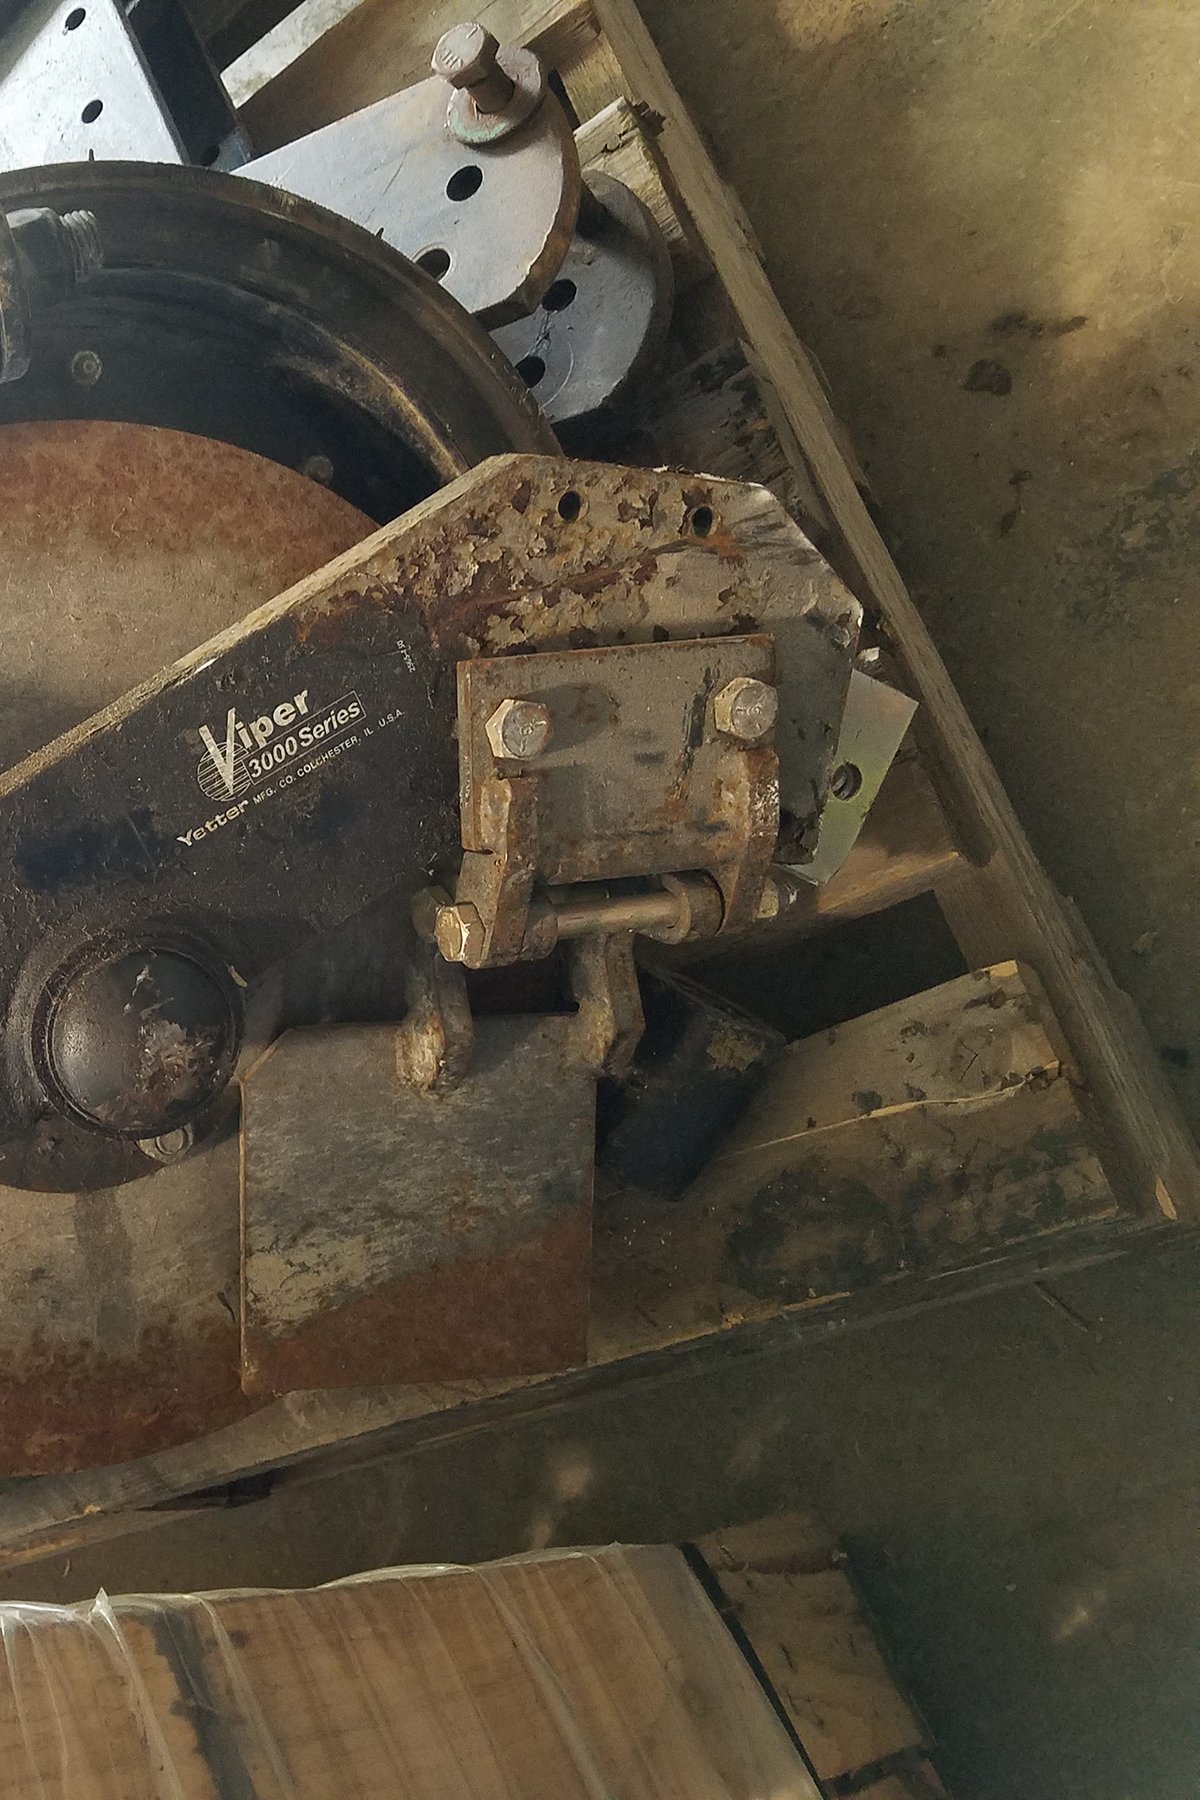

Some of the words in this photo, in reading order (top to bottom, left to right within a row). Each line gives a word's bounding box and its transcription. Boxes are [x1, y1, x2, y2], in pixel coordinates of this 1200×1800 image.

[176, 799, 249, 847] Yetter
[296, 735, 362, 777] COLCHESTER,
[378, 708, 405, 728] U.S.A.
[198, 689, 310, 795] Viper
[248, 736, 298, 778] 3000
[298, 702, 361, 747] Series
